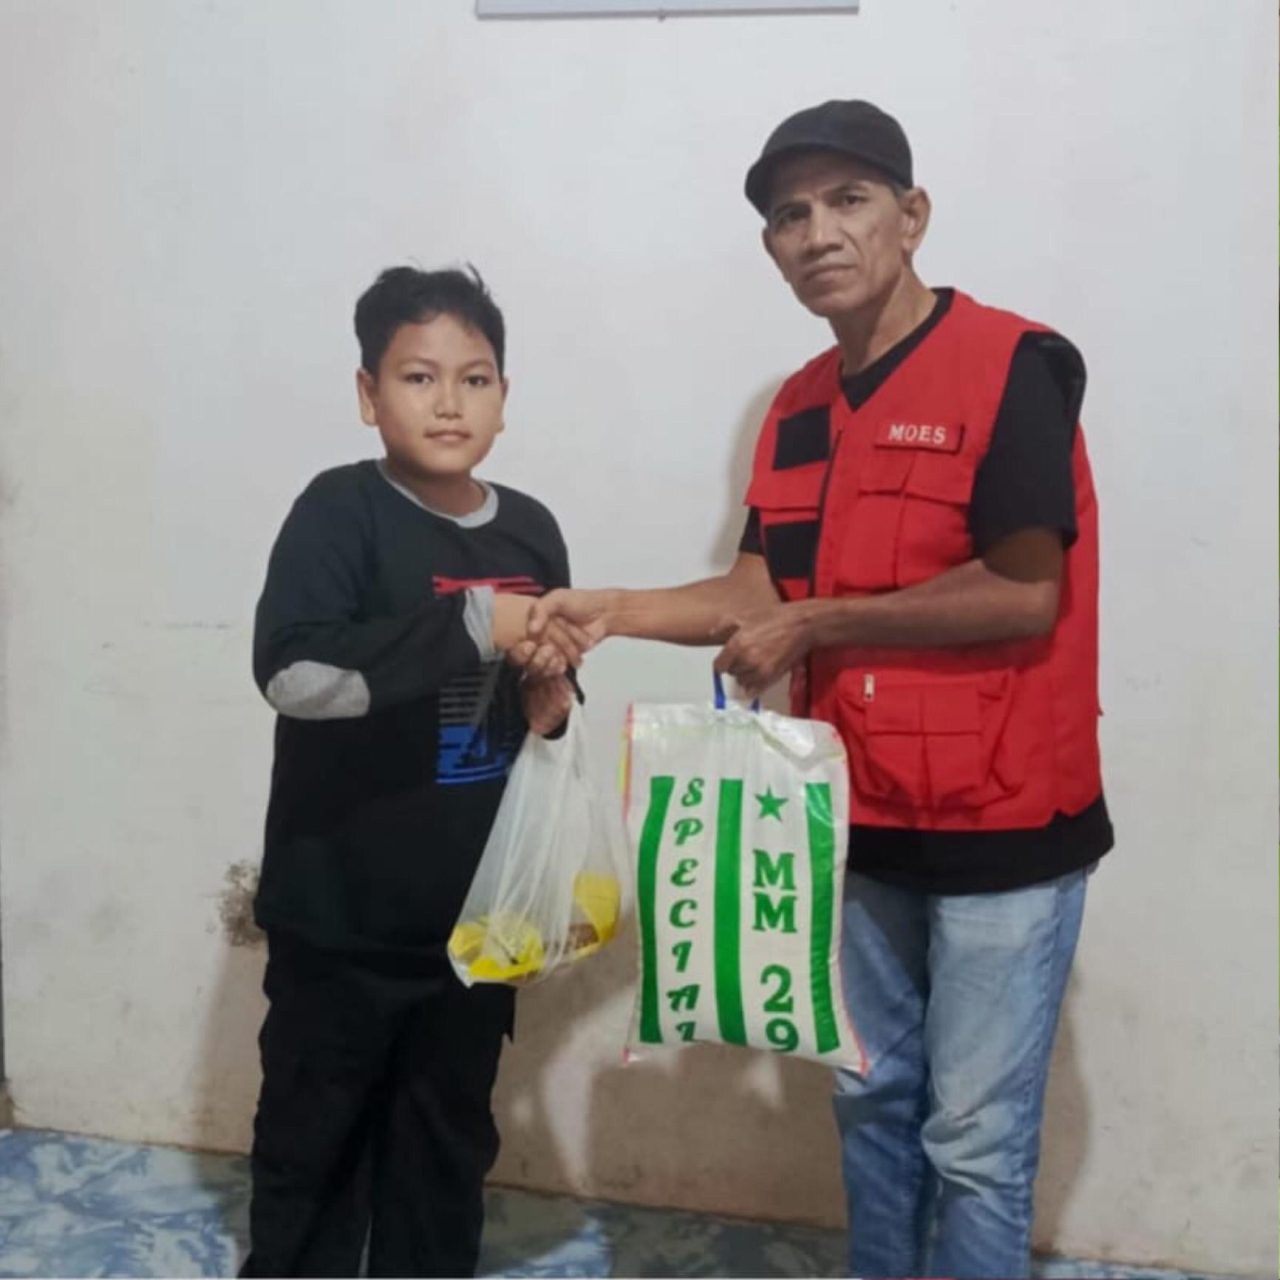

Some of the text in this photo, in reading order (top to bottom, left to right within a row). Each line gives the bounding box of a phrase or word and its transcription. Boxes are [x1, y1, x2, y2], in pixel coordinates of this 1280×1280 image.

[888, 423, 946, 444] MOES
[753, 850, 799, 1053] MM 29
